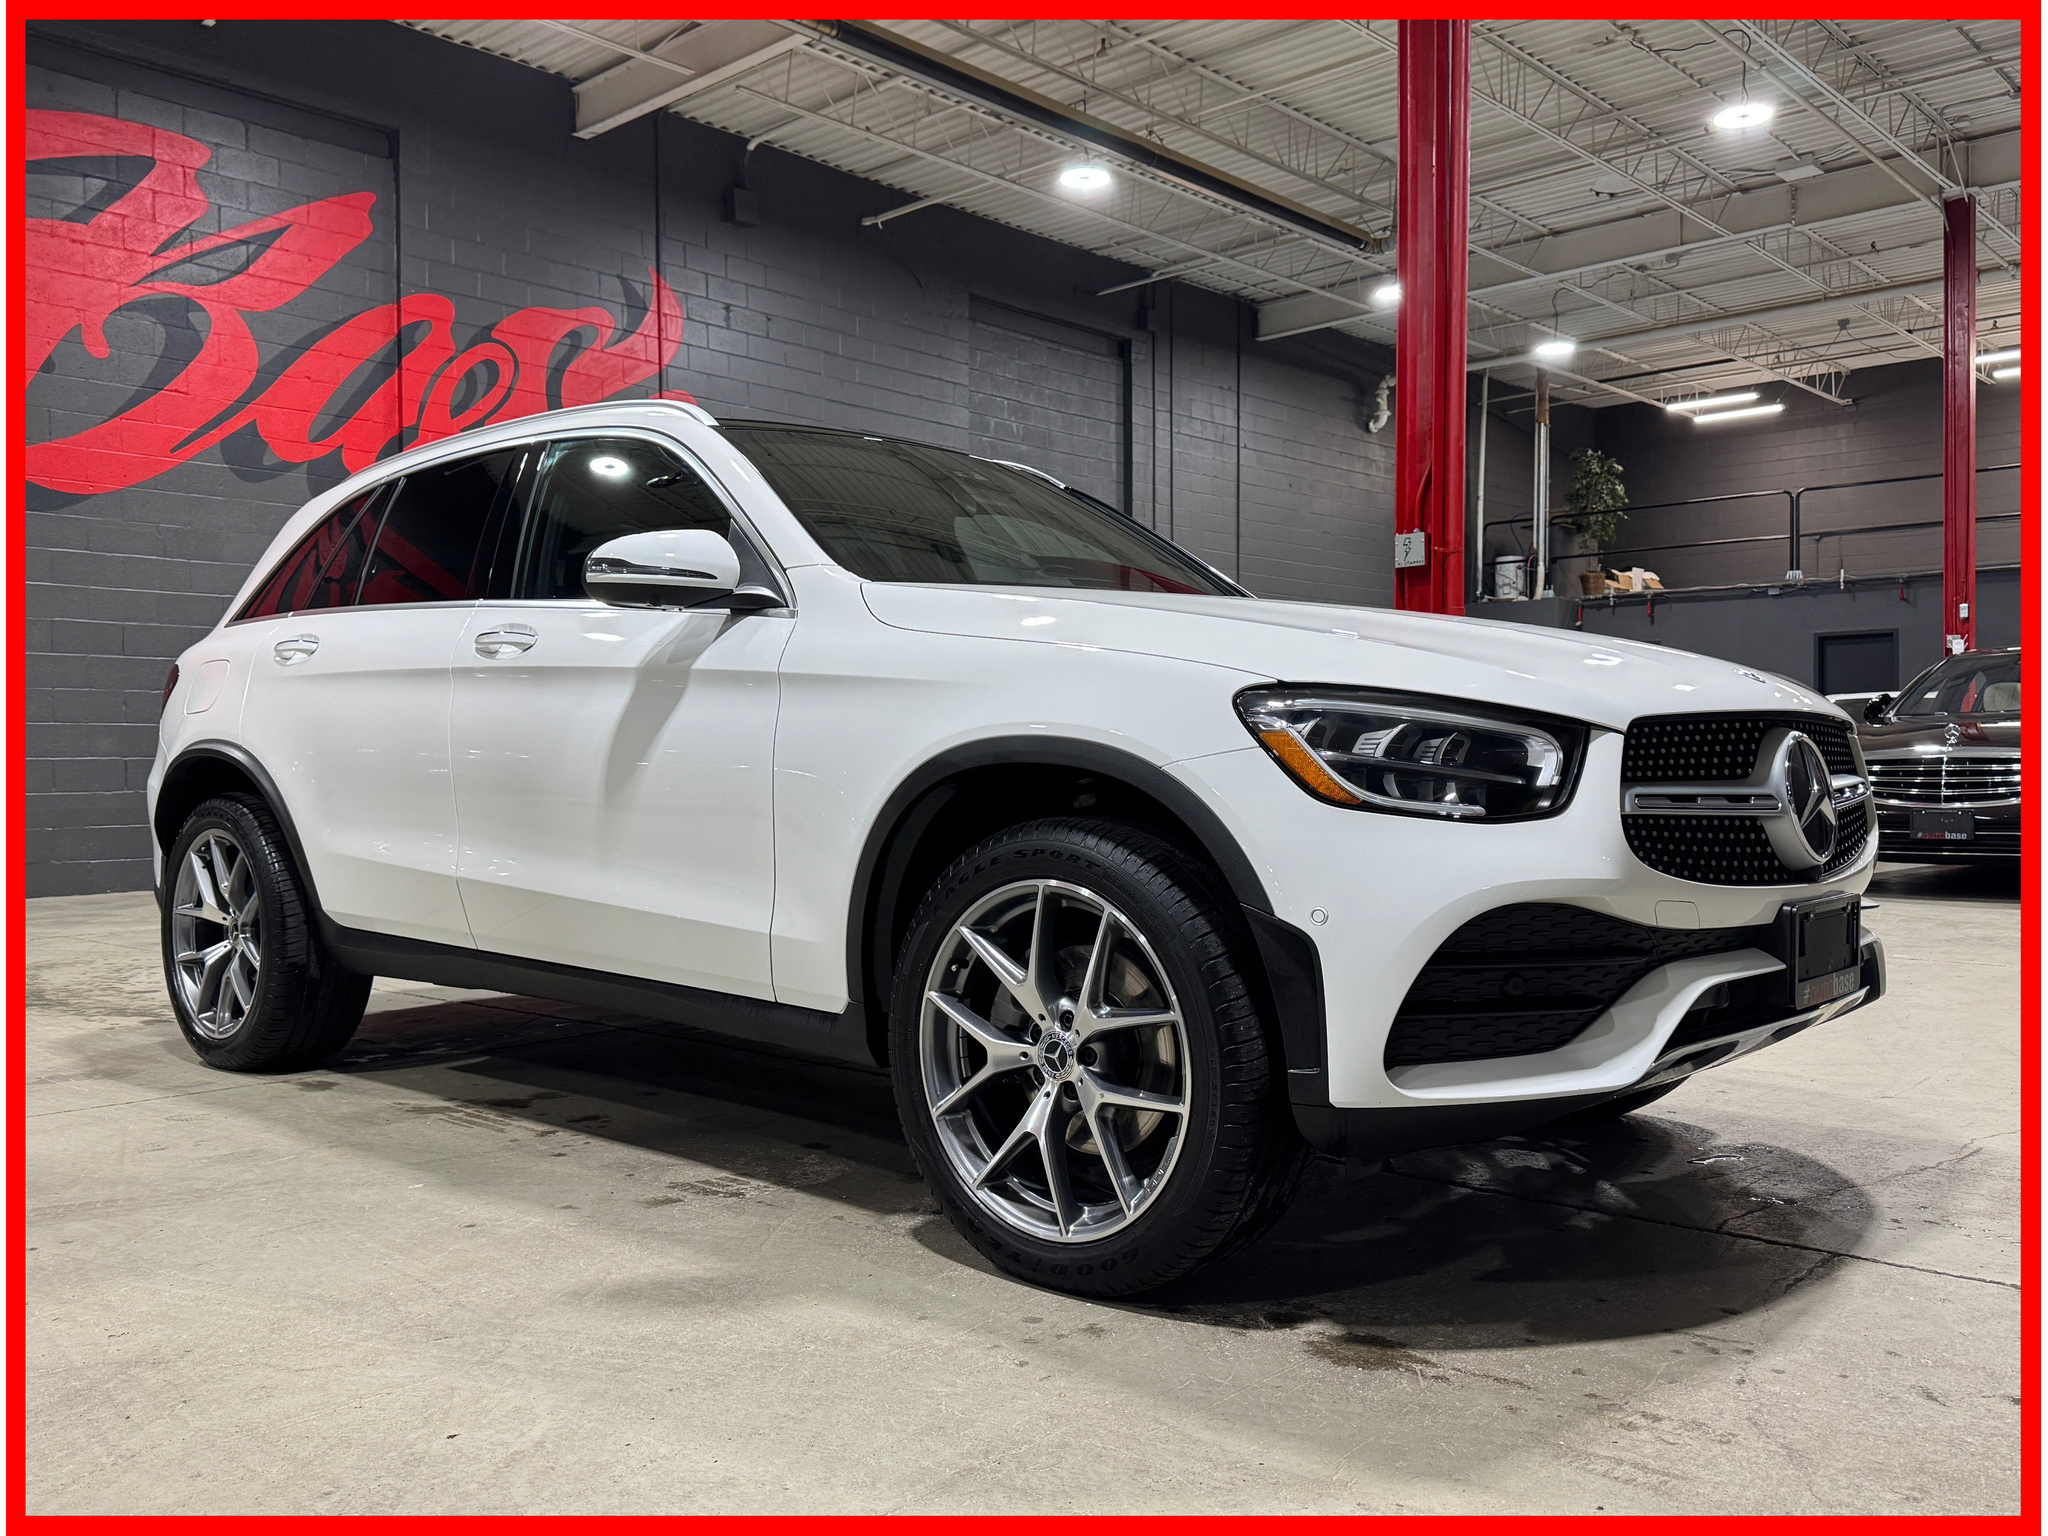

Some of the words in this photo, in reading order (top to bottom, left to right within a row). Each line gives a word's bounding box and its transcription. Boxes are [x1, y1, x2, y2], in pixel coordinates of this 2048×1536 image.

[932, 854, 1003, 915] EAGLE
[1013, 848, 1102, 870] SPORT
[1803, 972, 1855, 1005] #autobase
